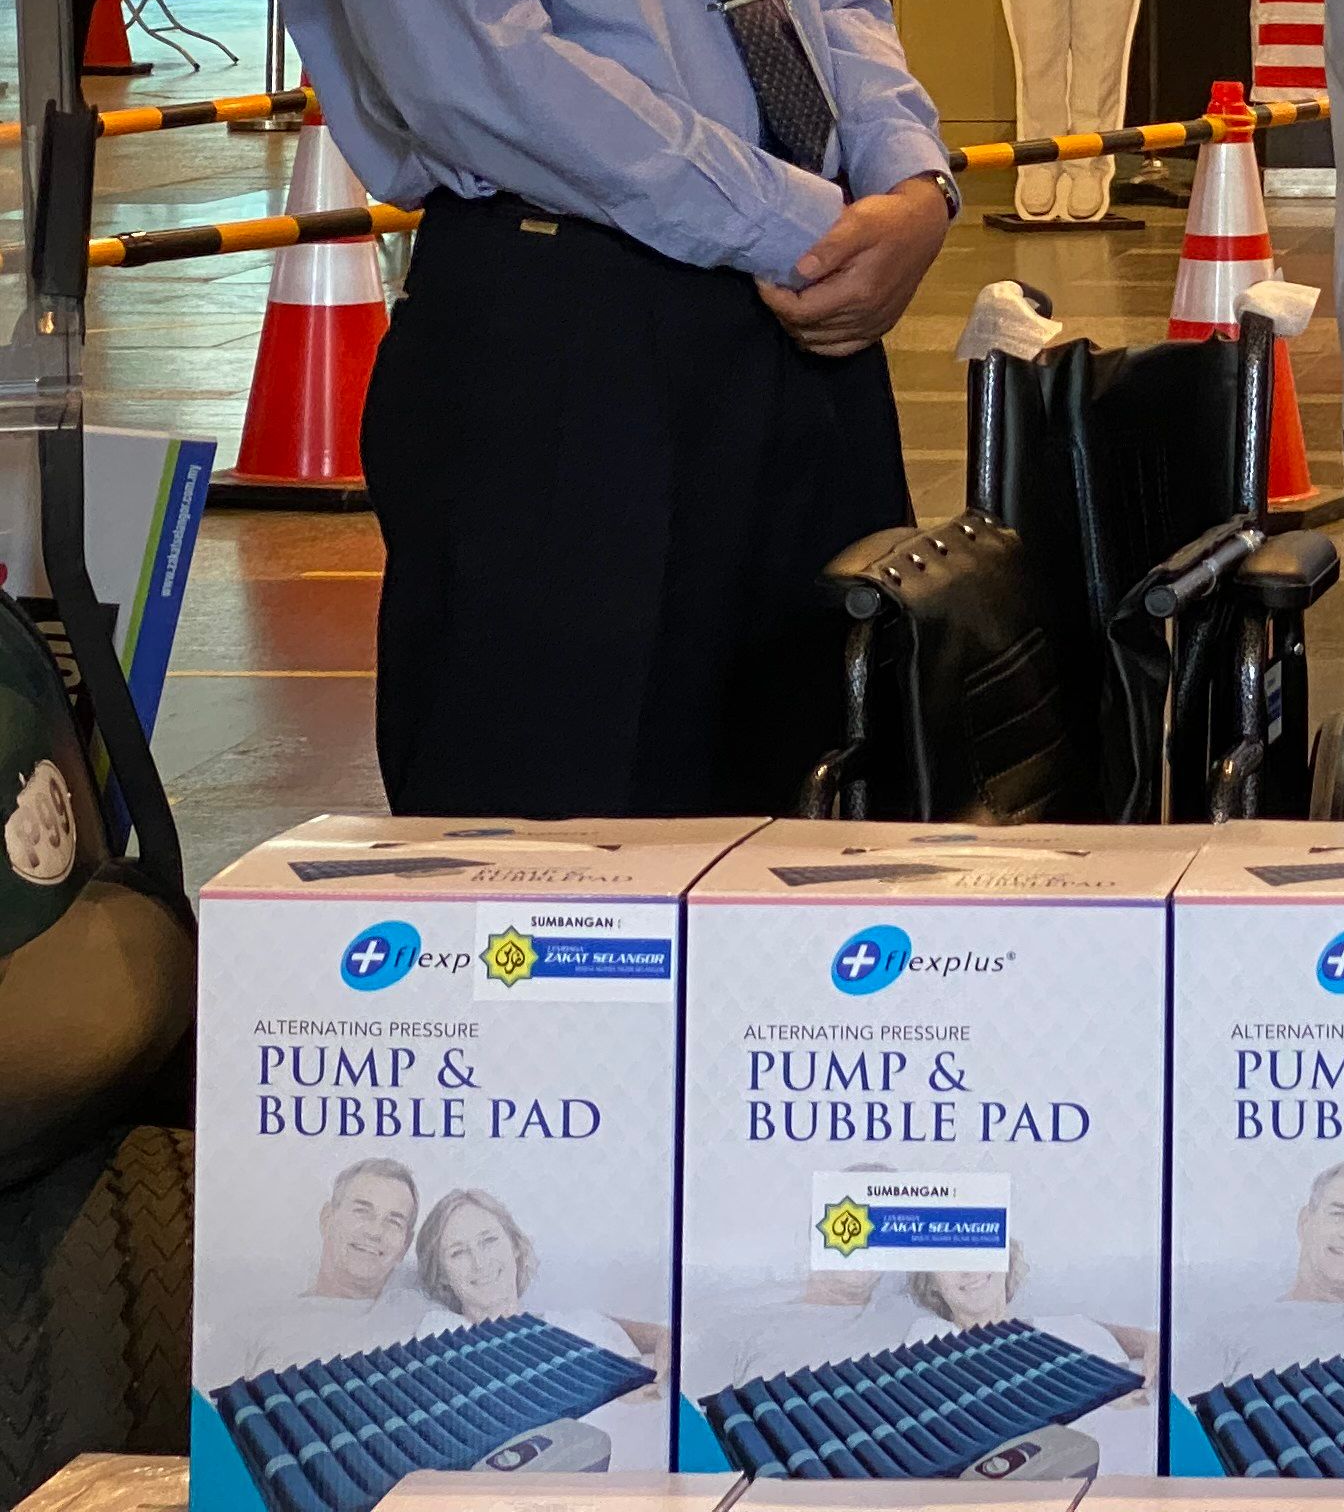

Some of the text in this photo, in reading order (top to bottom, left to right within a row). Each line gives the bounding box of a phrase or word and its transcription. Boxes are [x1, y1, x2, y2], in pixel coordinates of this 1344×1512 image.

[531, 916, 614, 928] SUMBANGAN
[544, 952, 665, 964] ZAKAT SELANGOR
[253, 1019, 479, 1038] ALTERNATING PRESSURE
[743, 1024, 970, 1041] ALTERNATING PRESSURE
[259, 1045, 481, 1089] PUMP &
[750, 1050, 973, 1092] PUMP &
[259, 1095, 601, 1139] BUBBLE PAD
[749, 1101, 1090, 1143] BUBBLE PAD
[867, 1185, 949, 1197] SUMBANGAN
[880, 1221, 1001, 1234] ZAKAT SELANGOR
